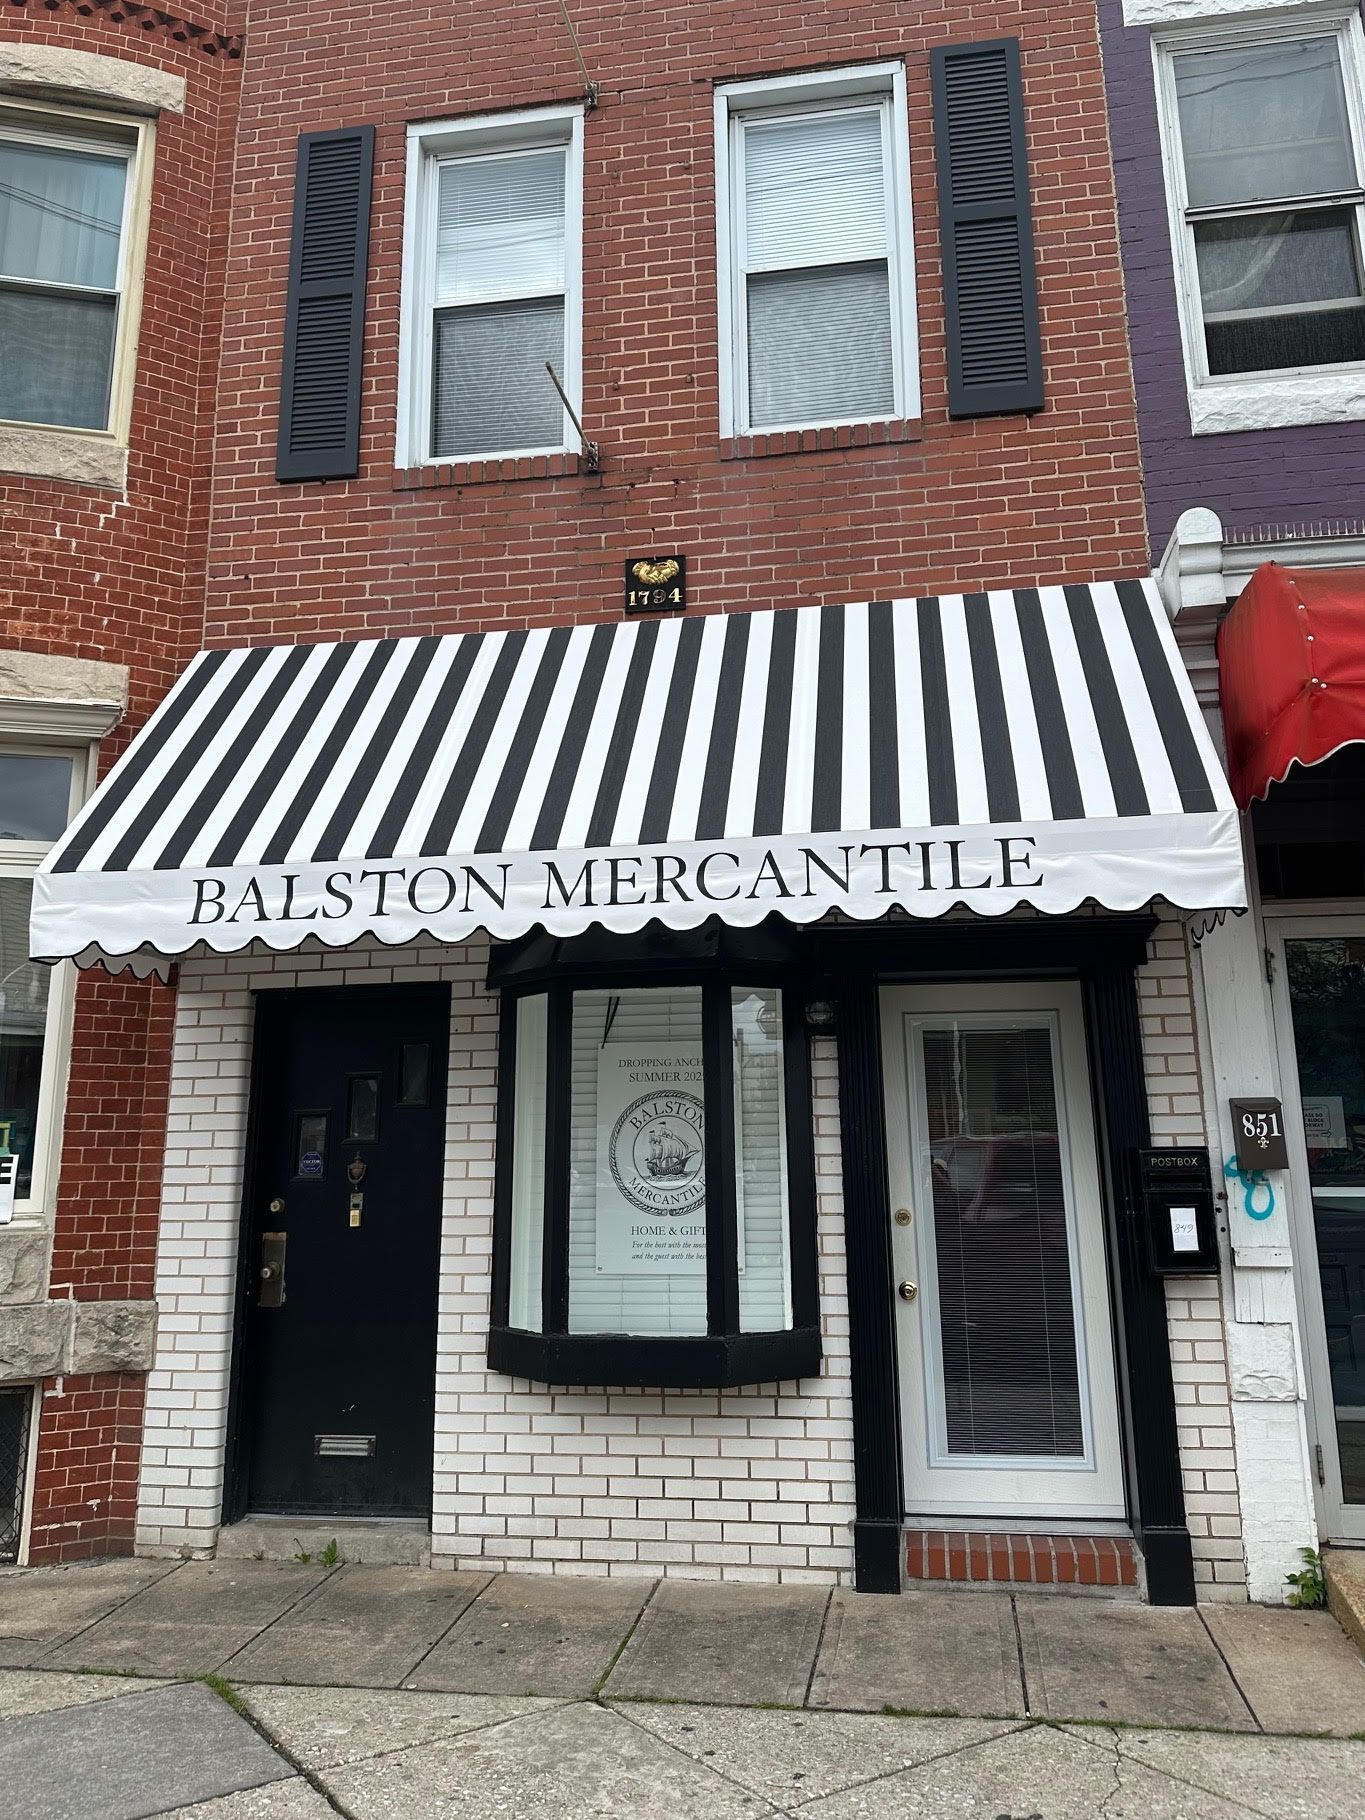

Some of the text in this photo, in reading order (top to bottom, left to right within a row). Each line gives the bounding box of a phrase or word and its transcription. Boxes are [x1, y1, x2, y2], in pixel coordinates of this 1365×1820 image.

[628, 587, 683, 606] 1794
[187, 837, 1044, 925] BALSTON MERCANTILE
[618, 1057, 704, 1068] DROPPING ANCH
[629, 1071, 703, 1082] SUMMER 202
[629, 1100, 704, 1131] BALSTON
[1242, 1113, 1282, 1137] 851
[1151, 1157, 1198, 1167] POSTBOX
[631, 1226, 667, 1236] HOME
[668, 1226, 677, 1236] &
[1174, 1223, 1194, 1234] 849
[632, 1240, 643, 1249] For
[644, 1240, 653, 1248] the
[632, 1252, 706, 1262] and the guest with the bes
